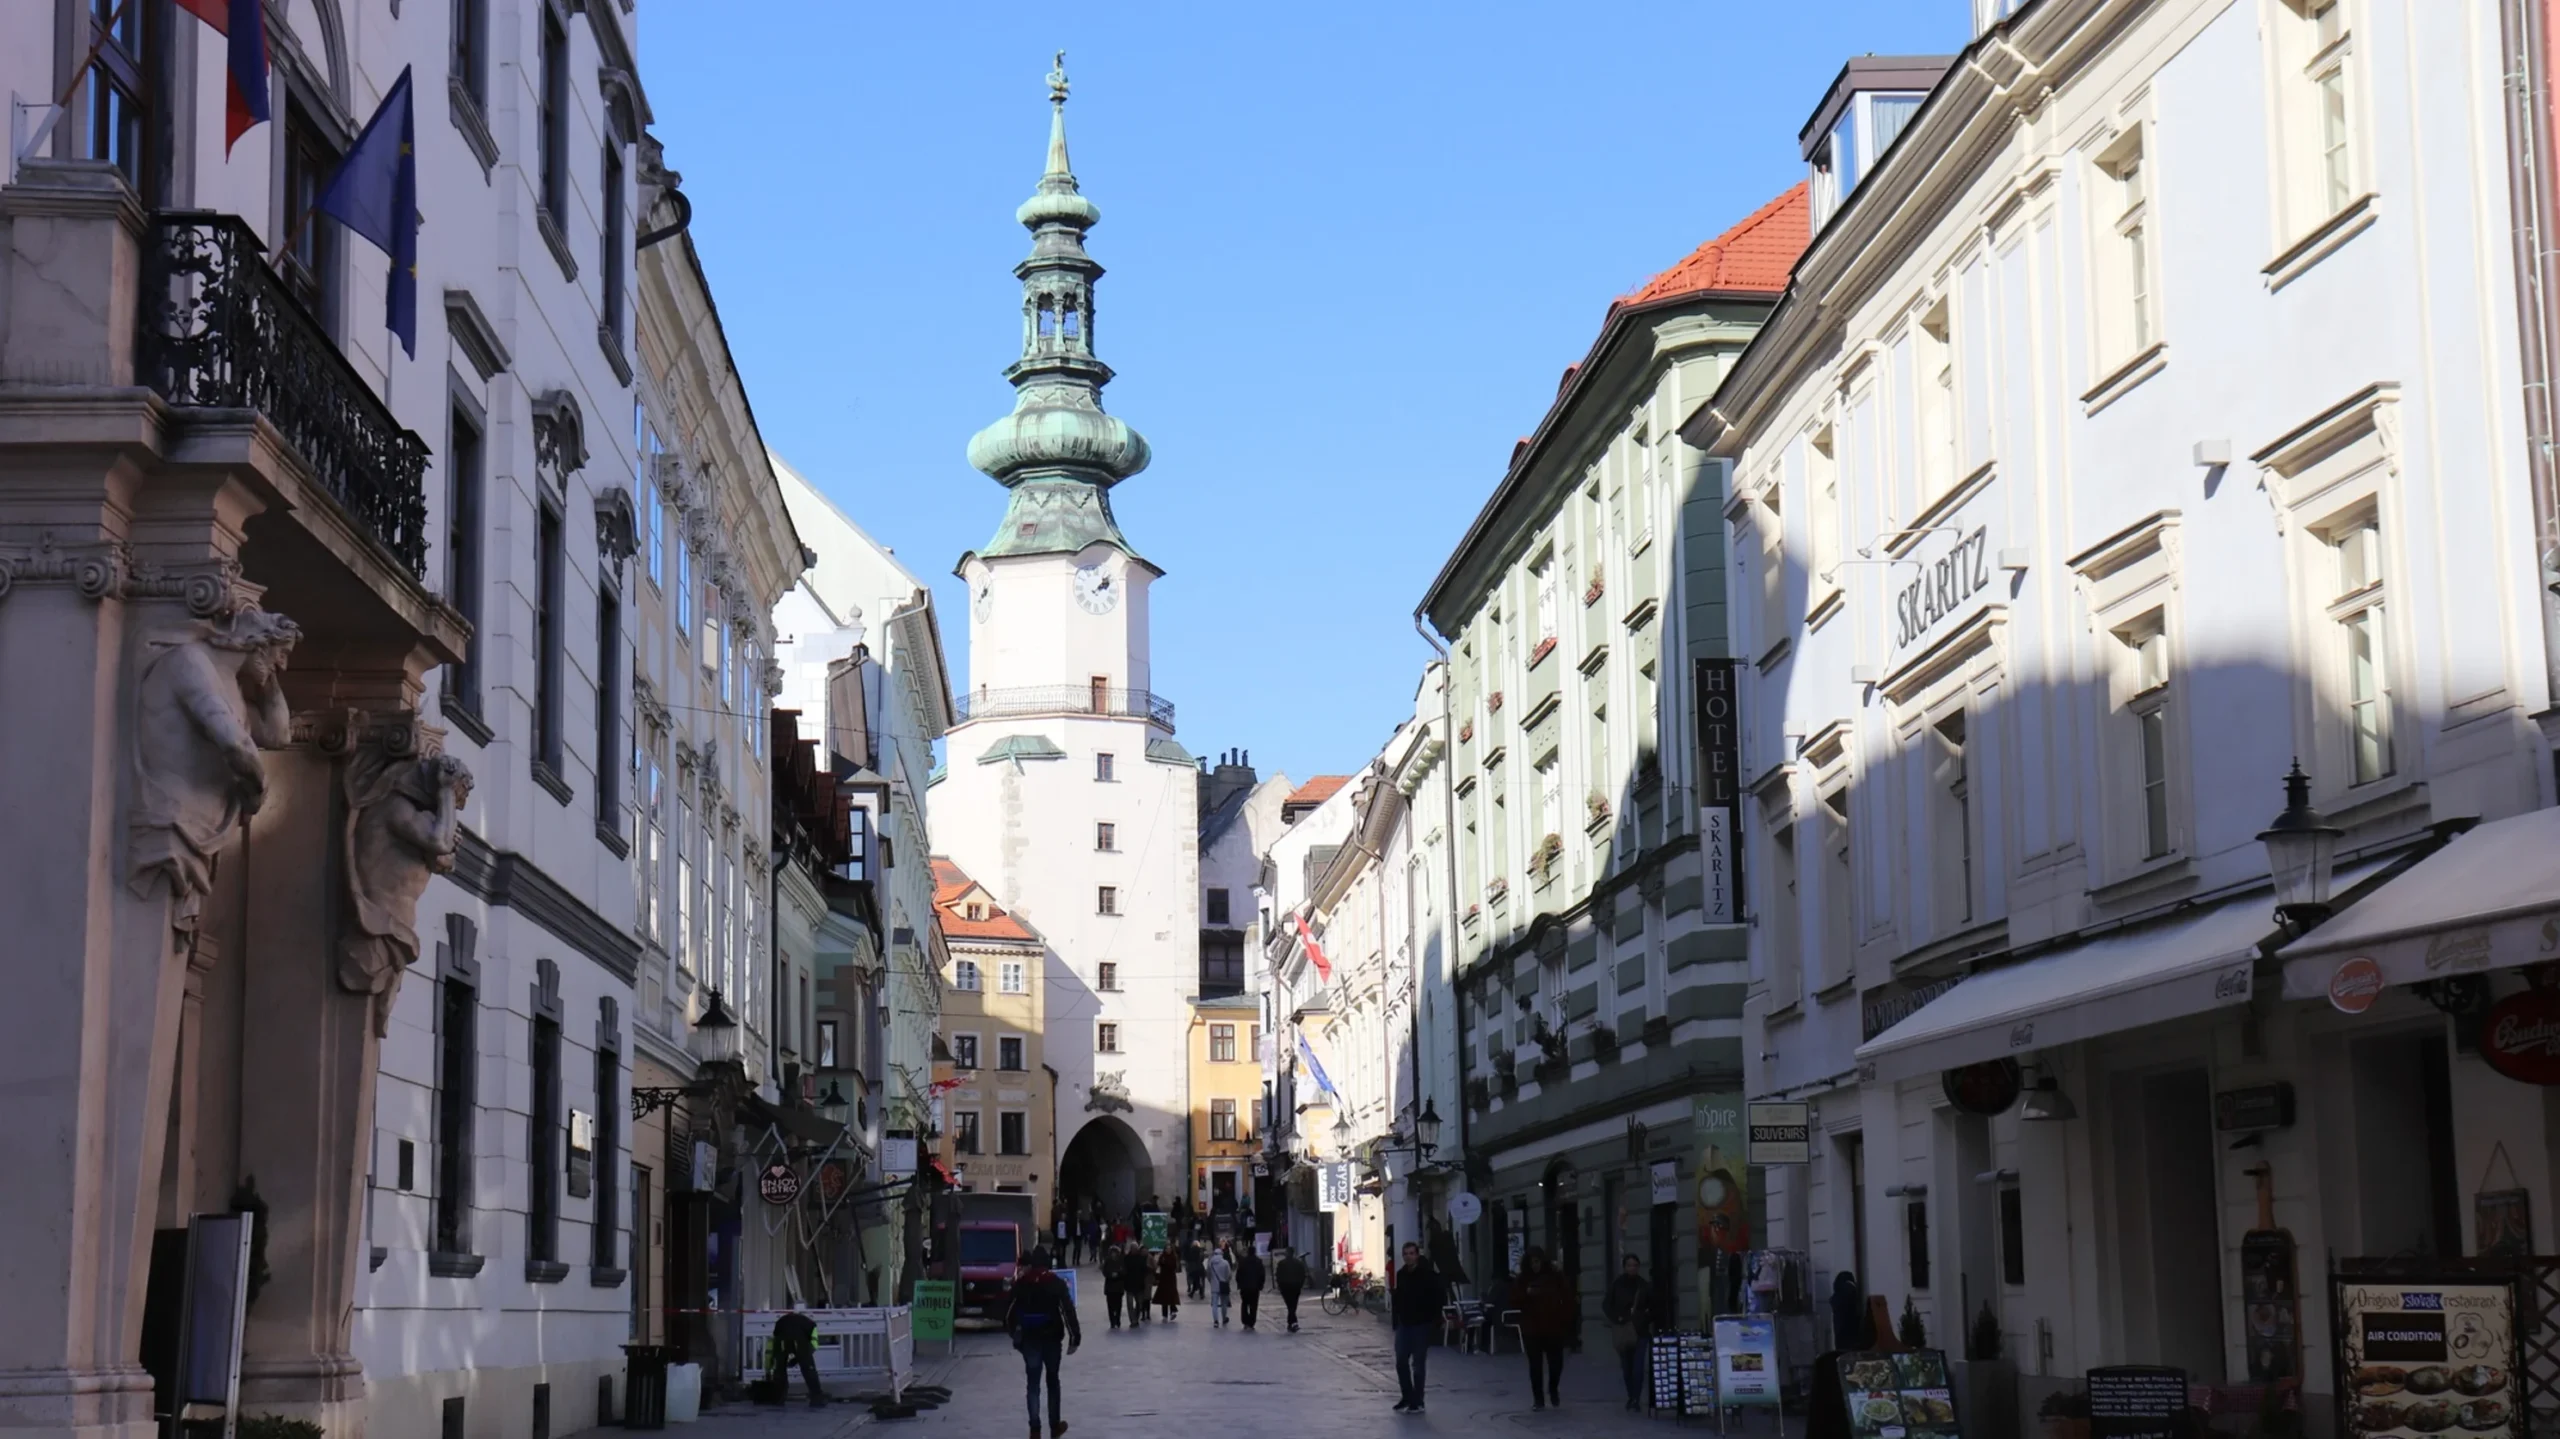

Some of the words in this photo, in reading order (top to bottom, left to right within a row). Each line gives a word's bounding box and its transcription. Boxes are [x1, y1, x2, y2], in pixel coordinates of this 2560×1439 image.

[1898, 523, 1988, 649] SKARITZ
[1706, 669, 1729, 801] HOTEL
[1711, 815, 1725, 916] SKARITZ
[2215, 969, 2248, 999] Coca-Cola
[1695, 1104, 1736, 1133] InSpire
[1754, 1126, 1806, 1141] SOUVENIRS
[762, 1178, 797, 1187] ENJOY
[762, 1185, 798, 1194] BISTRO
[1335, 1163, 1348, 1202] CIGÁR
[917, 1296, 952, 1311] ANTIQUES
[2357, 1288, 2399, 1310] Original
[2405, 1294, 2439, 1308] slovak
[2444, 1295, 2496, 1309] restaurant
[2368, 1331, 2385, 1341] AIR
[2387, 1331, 2442, 1341] CONDITION
